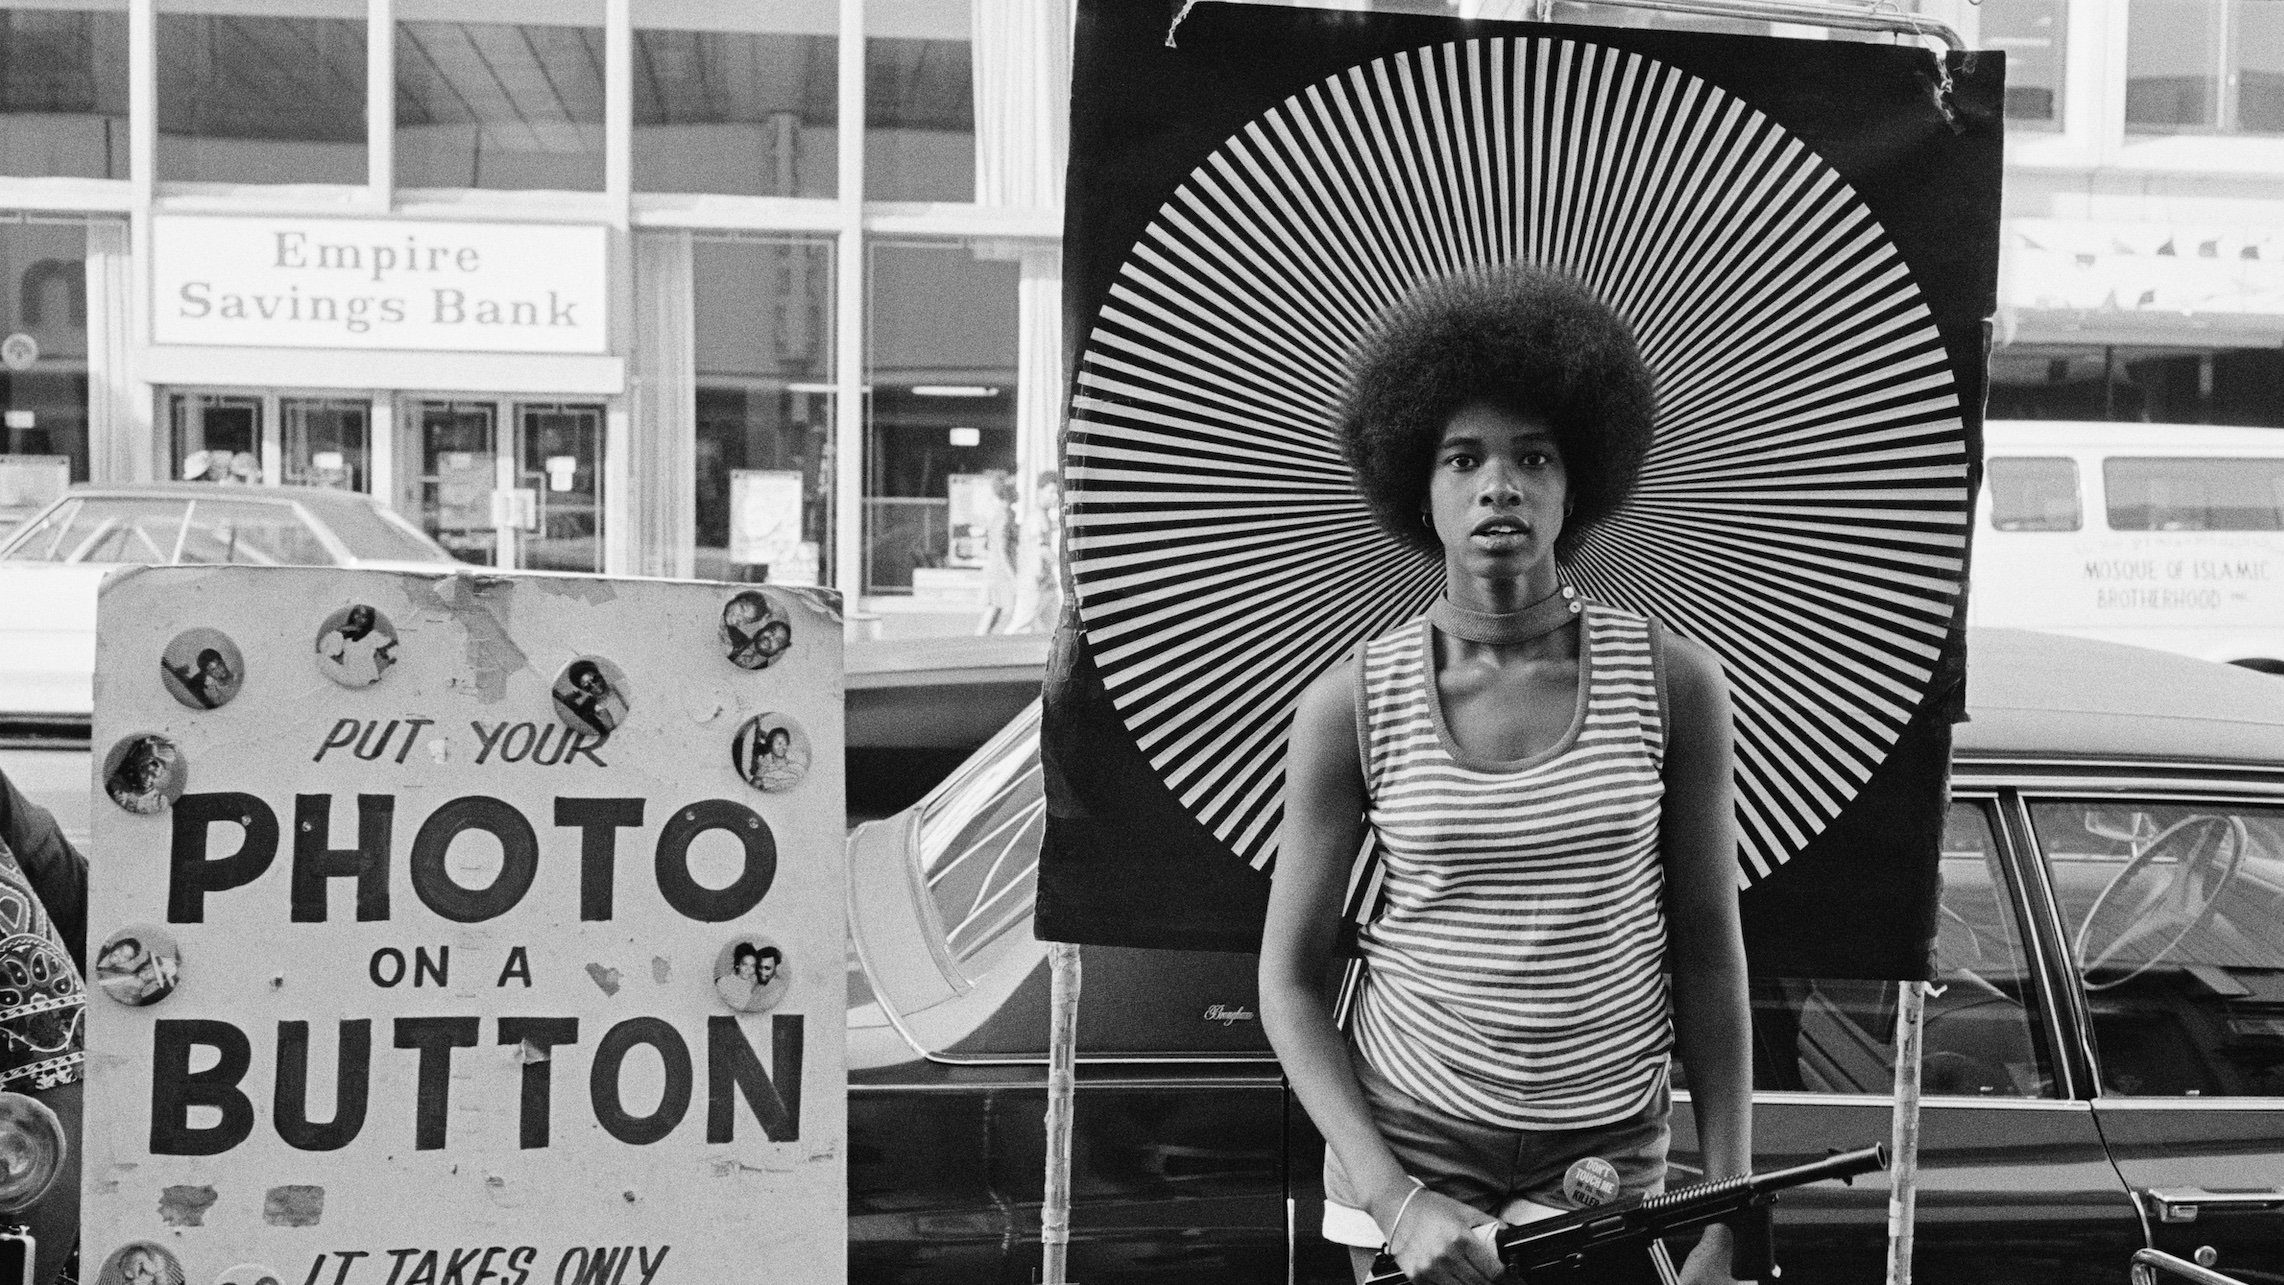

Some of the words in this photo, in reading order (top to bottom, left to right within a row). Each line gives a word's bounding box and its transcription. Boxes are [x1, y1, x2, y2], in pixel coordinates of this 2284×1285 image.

[273, 230, 481, 281] Empire
[179, 282, 407, 333] Savings
[431, 289, 579, 328] Bank
[2084, 560, 2157, 581] MOSQUE
[2166, 561, 2184, 579] OF
[2193, 561, 2272, 582] ISLAMIC
[2096, 587, 2222, 610] BROTHERHOOD
[312, 718, 435, 763] PUT
[471, 721, 608, 767] YOUR
[167, 792, 777, 923] PHOTO
[369, 945, 449, 988] ON
[497, 946, 533, 988] A
[150, 1014, 804, 1155] BUTTON
[1572, 1189, 1600, 1208] KILLER
[1576, 1167, 1602, 1189] TOUCH
[1600, 1180, 1615, 1194] ME
[385, 1246, 538, 1285] TAKES
[553, 1245, 671, 1285] ONLY
